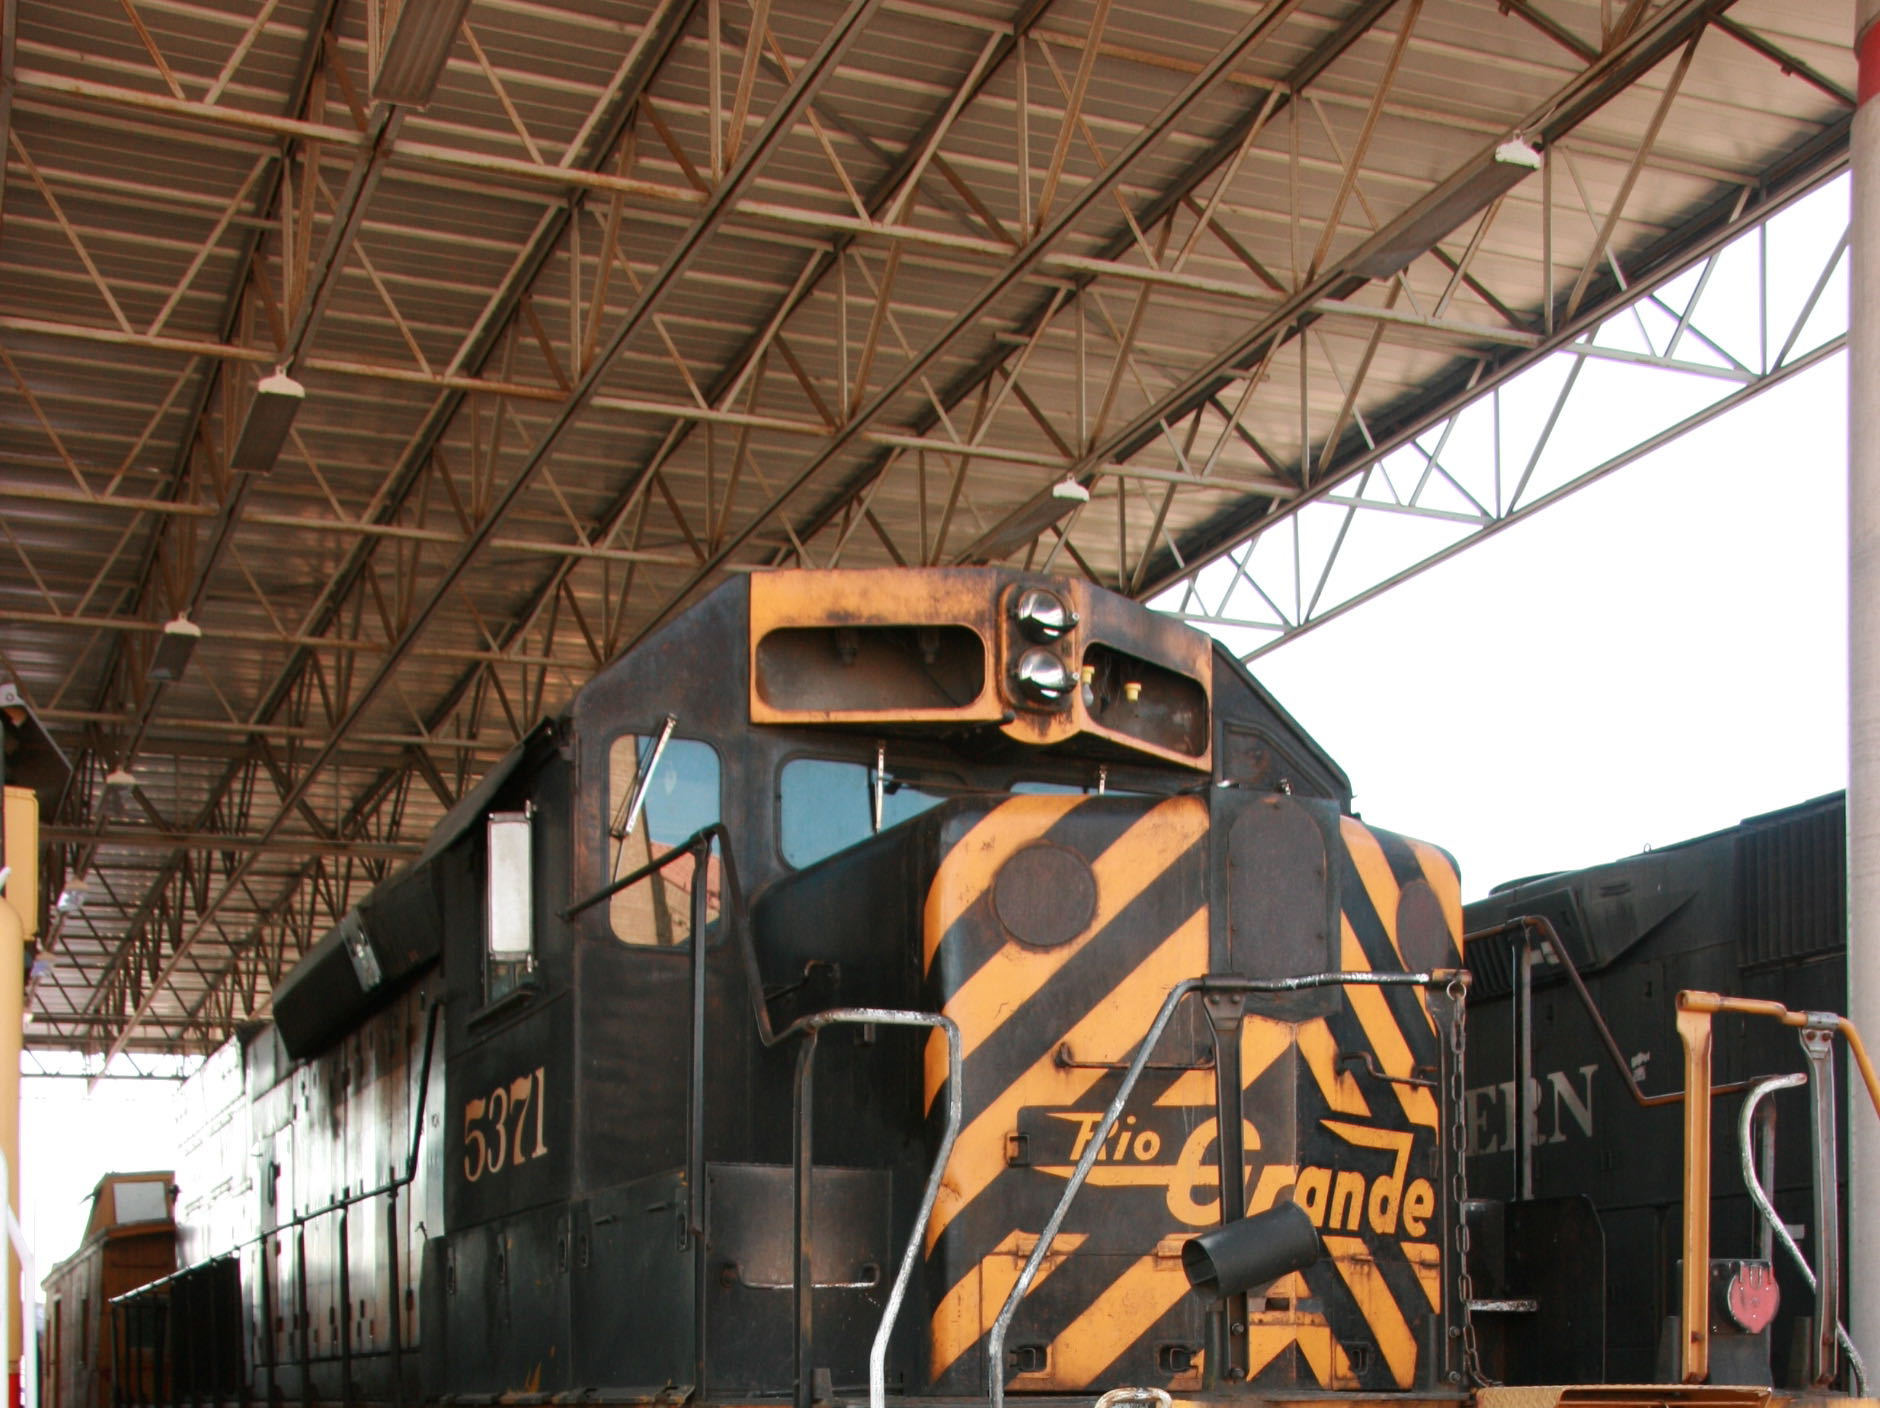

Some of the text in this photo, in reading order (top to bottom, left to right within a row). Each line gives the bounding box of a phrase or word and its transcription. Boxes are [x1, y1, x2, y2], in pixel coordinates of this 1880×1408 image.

[464, 1066, 548, 1182] 5371
[1048, 1112, 1436, 1238] Rio Grande
